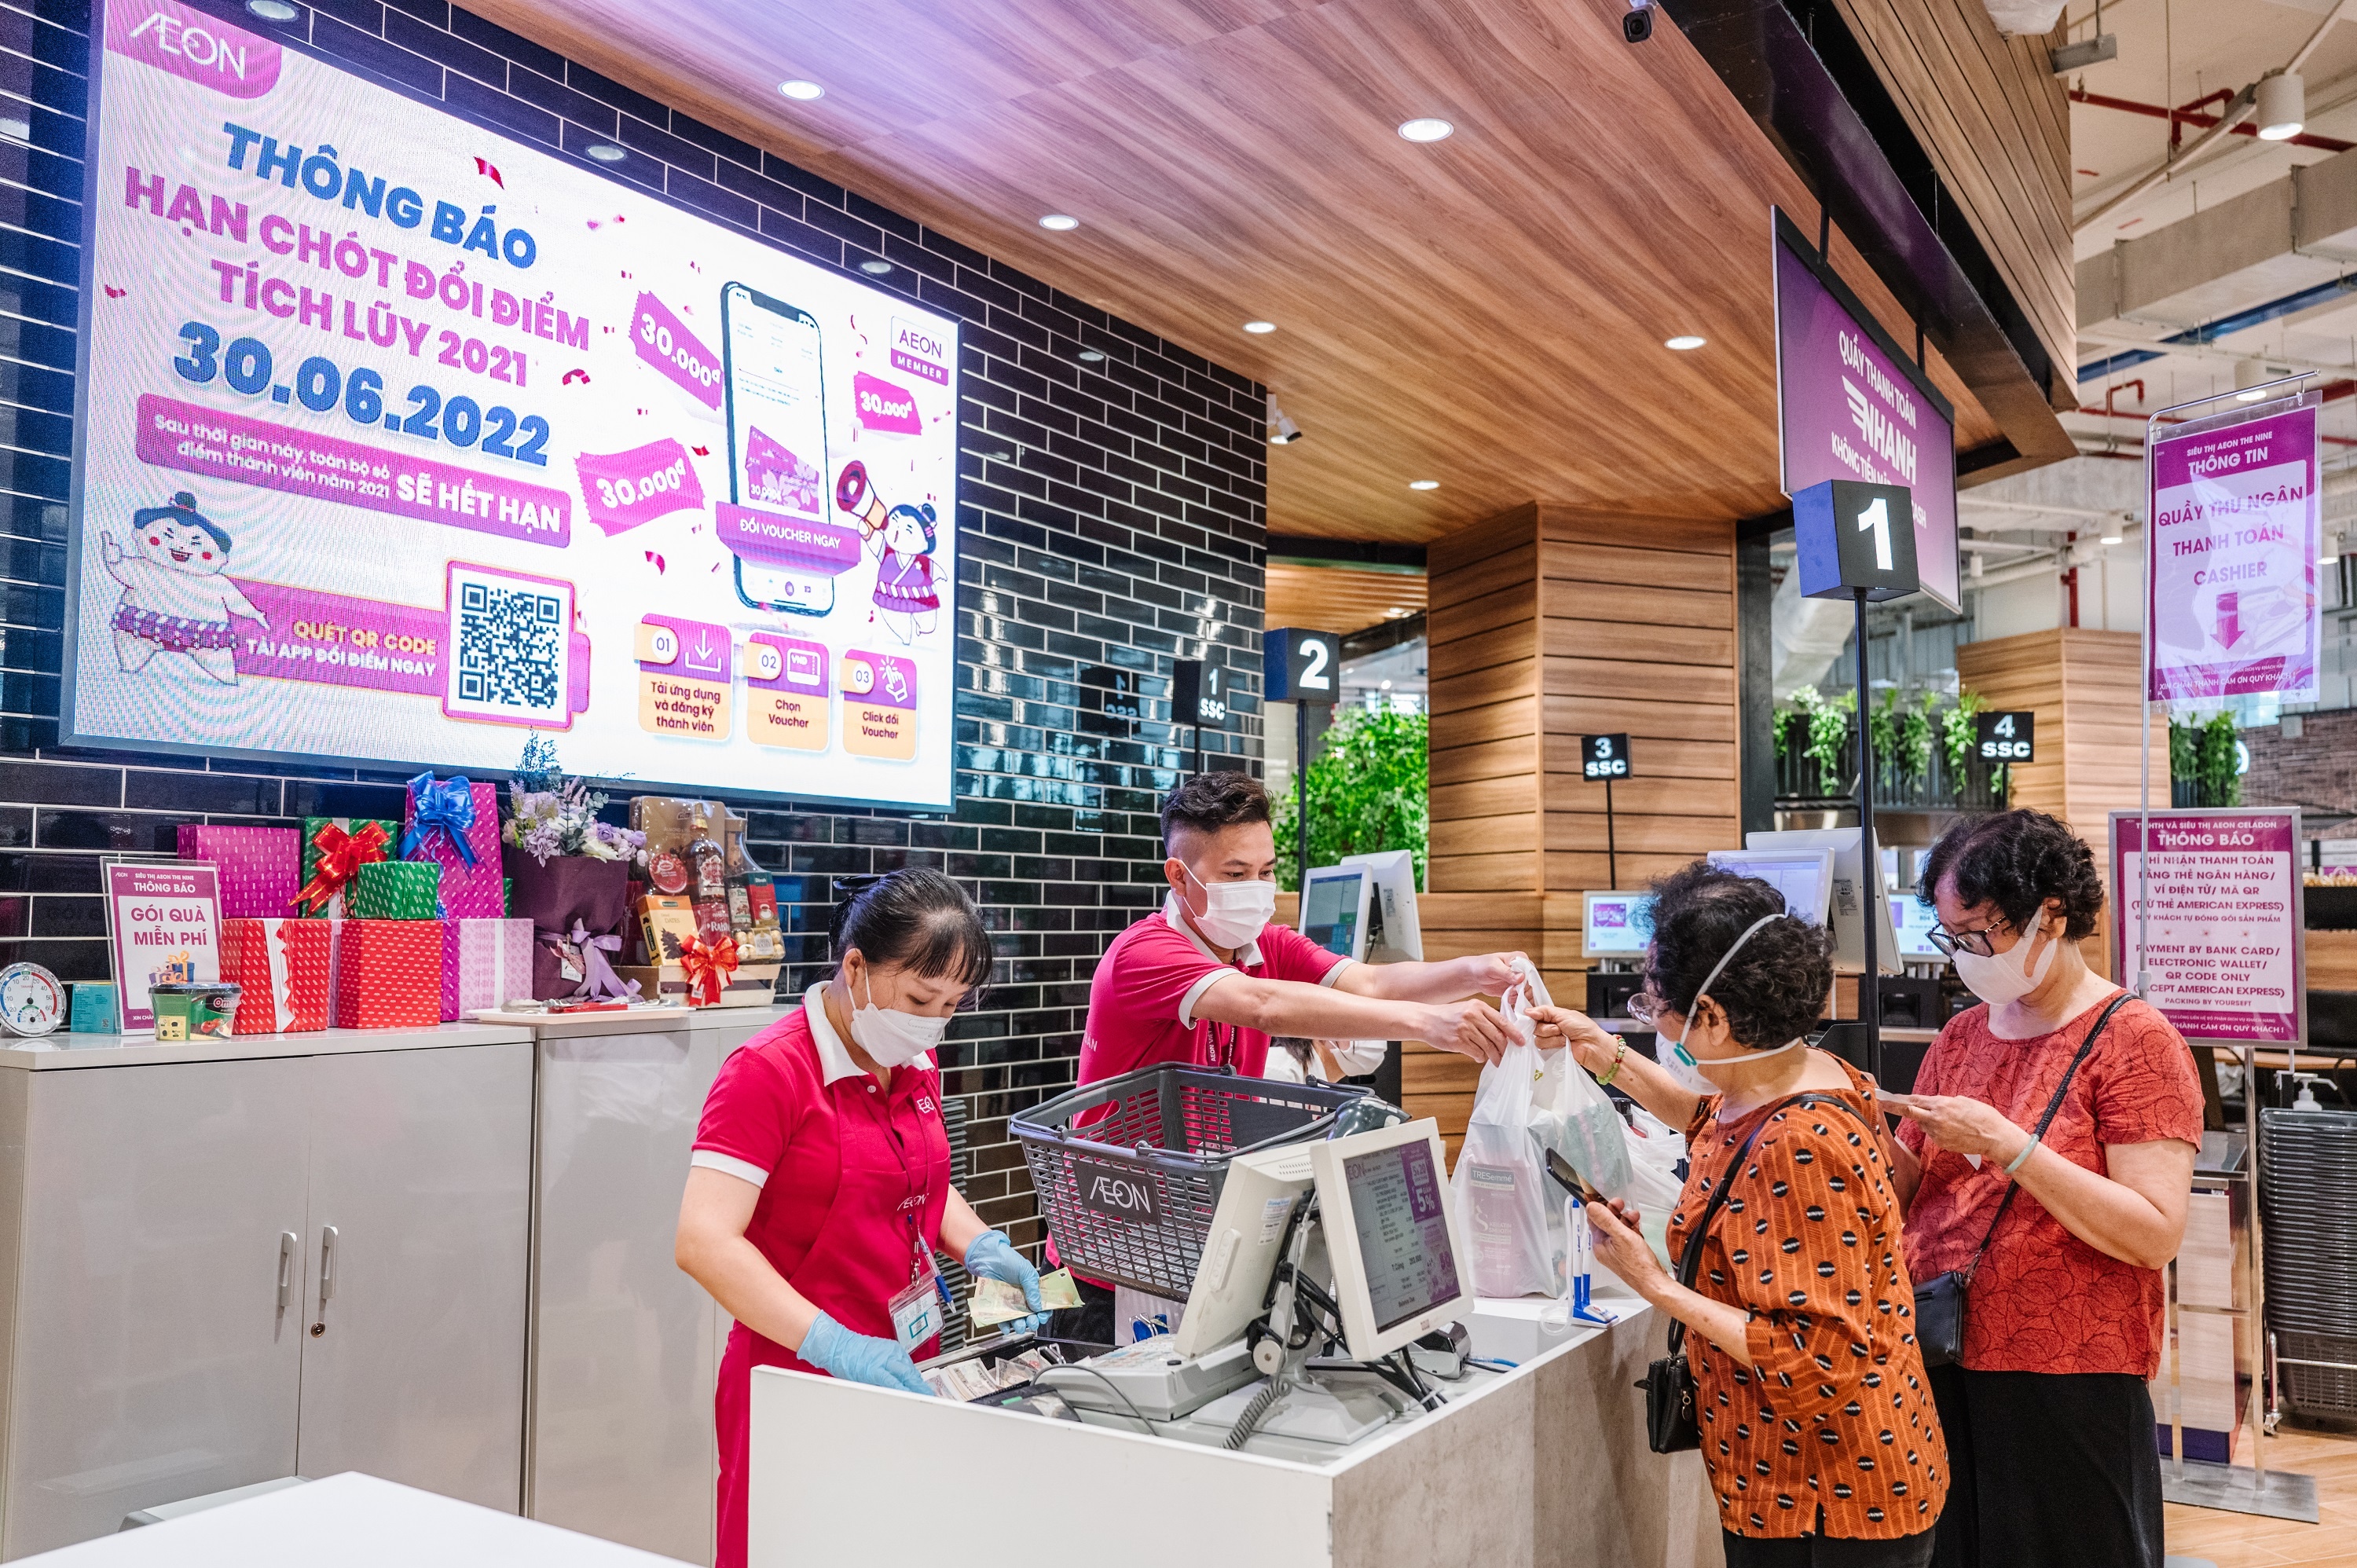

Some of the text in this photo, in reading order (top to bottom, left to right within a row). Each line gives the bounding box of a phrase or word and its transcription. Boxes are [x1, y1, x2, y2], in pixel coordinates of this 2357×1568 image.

[223, 122, 537, 269] THÔNG BÁO
[124, 166, 590, 350] HẠN CHÓT ĐỔI ĐIỂM
[211, 259, 528, 387] TÍCH LŨY 2021
[899, 328, 943, 359] AEON
[897, 356, 943, 380] MEMBER
[1838, 330, 1917, 430] QUẦY THANH TOÁN
[174, 321, 550, 467] 30.06.2022
[154, 414, 189, 433] Sau
[229, 431, 269, 454] gian
[350, 458, 369, 476] bộ
[1831, 430, 1860, 474] KHÔNG
[1862, 399, 1917, 486] NHANH
[2187, 431, 2273, 456] SIÊU THỊ AEON THE NINE
[2188, 446, 2268, 475] THÔNG TIN
[280, 463, 317, 483] viên
[355, 480, 390, 499] 2021
[397, 472, 561, 534] SẼ HẾT HẠN
[2158, 485, 2303, 527] QUẦY THU NGÂN
[761, 523, 841, 549] VOUCHER NGAY
[1857, 496, 1894, 572] 1
[2173, 522, 2284, 556] THANH TOÁN
[2194, 561, 2268, 586] CASHIER
[293, 620, 438, 656] QUÉT QR CODE
[655, 637, 671, 653] 01
[278, 643, 313, 660] APP
[392, 658, 437, 676] NGAY
[761, 654, 777, 669] 02
[1299, 638, 1331, 691] 2
[856, 669, 871, 683] 03
[1208, 667, 1219, 696] 1
[2160, 682, 2171, 691] XIN
[2249, 672, 2264, 684] QUÝ
[2265, 670, 2292, 682] KHÁCH
[651, 681, 721, 705] Tải dụng
[654, 699, 669, 713] và
[775, 699, 801, 713] Chọn
[1200, 698, 1226, 720] SSC
[655, 716, 715, 734] thành viên
[768, 713, 809, 729] Voucher
[862, 711, 884, 724] Click
[1994, 715, 2015, 738] 4
[861, 725, 900, 740] Voucher
[1595, 737, 1612, 759] 3
[1981, 742, 2031, 757] SSC
[1585, 760, 1626, 777] SSC
[2157, 830, 2254, 846] THÔNG BÁO
[2164, 854, 2274, 866] NHẬN THANH TOÁN
[2174, 868, 2193, 879] THẺ
[2197, 870, 2231, 880] NGÂN
[134, 881, 196, 894] THÔNG BÁO
[2154, 884, 2260, 896] VÍ ĐIỆN MÃ QR
[130, 904, 206, 923] GÓI QUÀ
[2157, 899, 2284, 912] THẺ AMERICAN EXPRESS)
[2194, 914, 2219, 922] ĐÓNG
[2221, 914, 2237, 922] GÓI
[134, 925, 207, 946] MIỄN PHÍ
[2206, 946, 2238, 954] BANK
[2241, 947, 2280, 957] CARD/
[2149, 958, 2267, 970] ELECTRONIC WALLET/
[2165, 971, 2251, 982] QR CODE ONLY
[2177, 984, 2286, 998] AMERICAN EXPRESS)
[2219, 1023, 2231, 1031] ƠN
[2233, 1023, 2249, 1033] QUÝ
[2251, 1023, 2279, 1033] KHÁCH
[1472, 1171, 1512, 1182] TRESemmé
